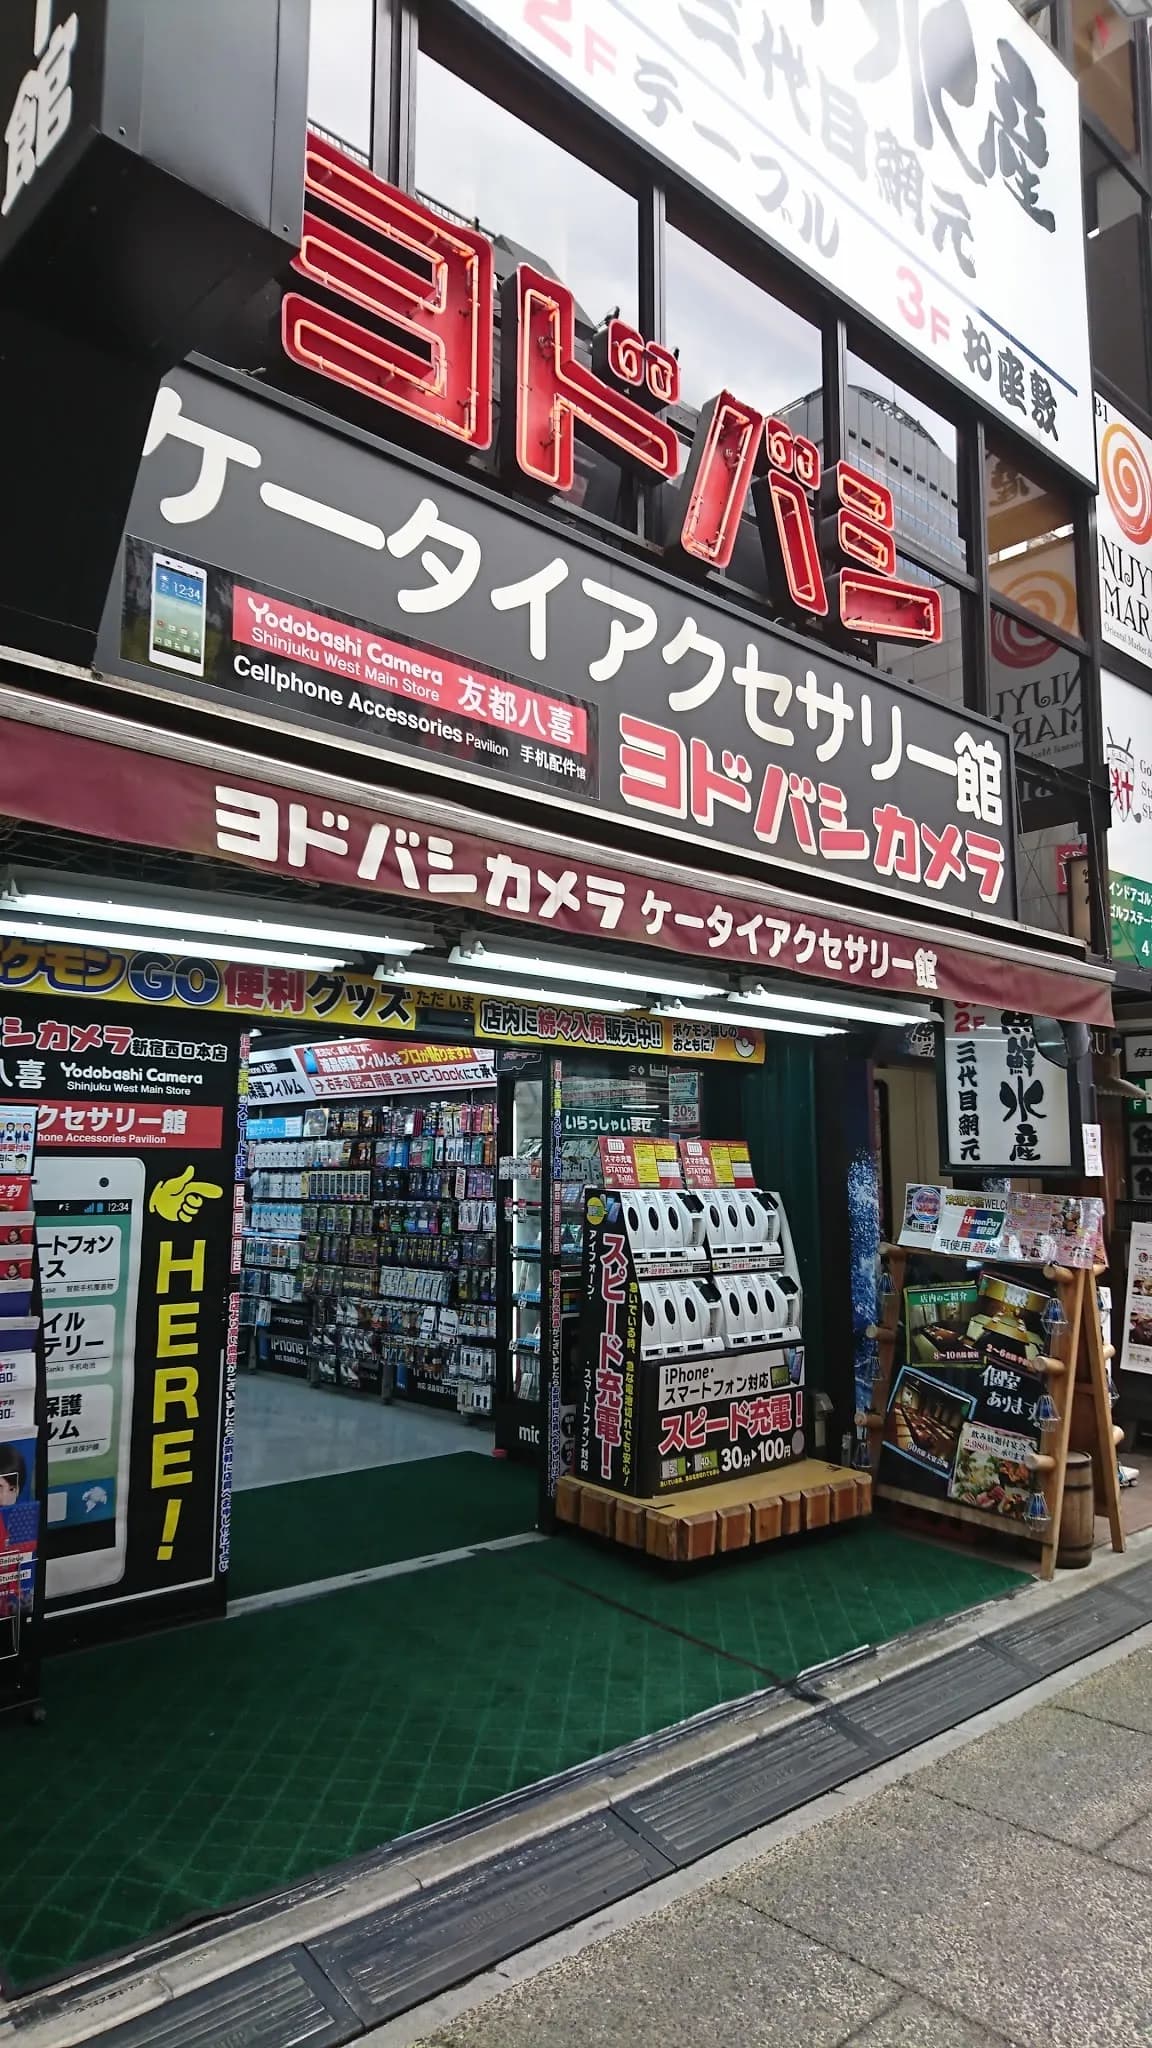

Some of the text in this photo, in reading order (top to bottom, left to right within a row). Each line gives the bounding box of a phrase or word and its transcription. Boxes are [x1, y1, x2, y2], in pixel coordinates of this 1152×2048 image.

[634, 53, 840, 260] テーブル
[896, 266, 1058, 442] 3F お座敷
[281, 130, 942, 645] ヨドバシ
[1100, 534, 1152, 598] NIJY
[143, 387, 1003, 827] ケータイアクセサリー館
[247, 596, 575, 745] Yodobashi Camera 友都八喜
[252, 626, 440, 701] Shinjuku West Main Store
[233, 655, 344, 706] Cellphone
[349, 691, 463, 743] Accessories
[466, 732, 509, 758] Pavilion
[619, 712, 1005, 904] ヨドバシカメラ
[215, 785, 626, 930] ヨドバシカメラ
[1109, 881, 1152, 906] インドアゴル
[1110, 904, 1152, 925] ゴルフステー
[641, 889, 939, 990] ケータイアクセサリー館
[0, 1016, 228, 1063] シカメラ新宿西口本店
[954, 1012, 985, 1033] 2F
[60, 1061, 143, 1082] Yodobashi
[146, 1068, 203, 1085] Camera
[67, 1081, 191, 1096] Shinjuku West Main Store
[565, 1115, 652, 1133] いらっしゃいませ
[673, 1105, 696, 1117] 30%
[957, 1040, 981, 1162] 三代目網元
[66, 1133, 126, 1144] Accessories
[129, 1134, 166, 1145] Pavilion
[605, 1165, 634, 1174] STATION
[964, 1216, 1000, 1230] UnionPay
[151, 1240, 206, 1561] HERE!
[665, 1373, 769, 1406] スマートフォン対応
[979, 1364, 1022, 1391] 個室
[721, 1436, 791, 1472] 30分 100円
